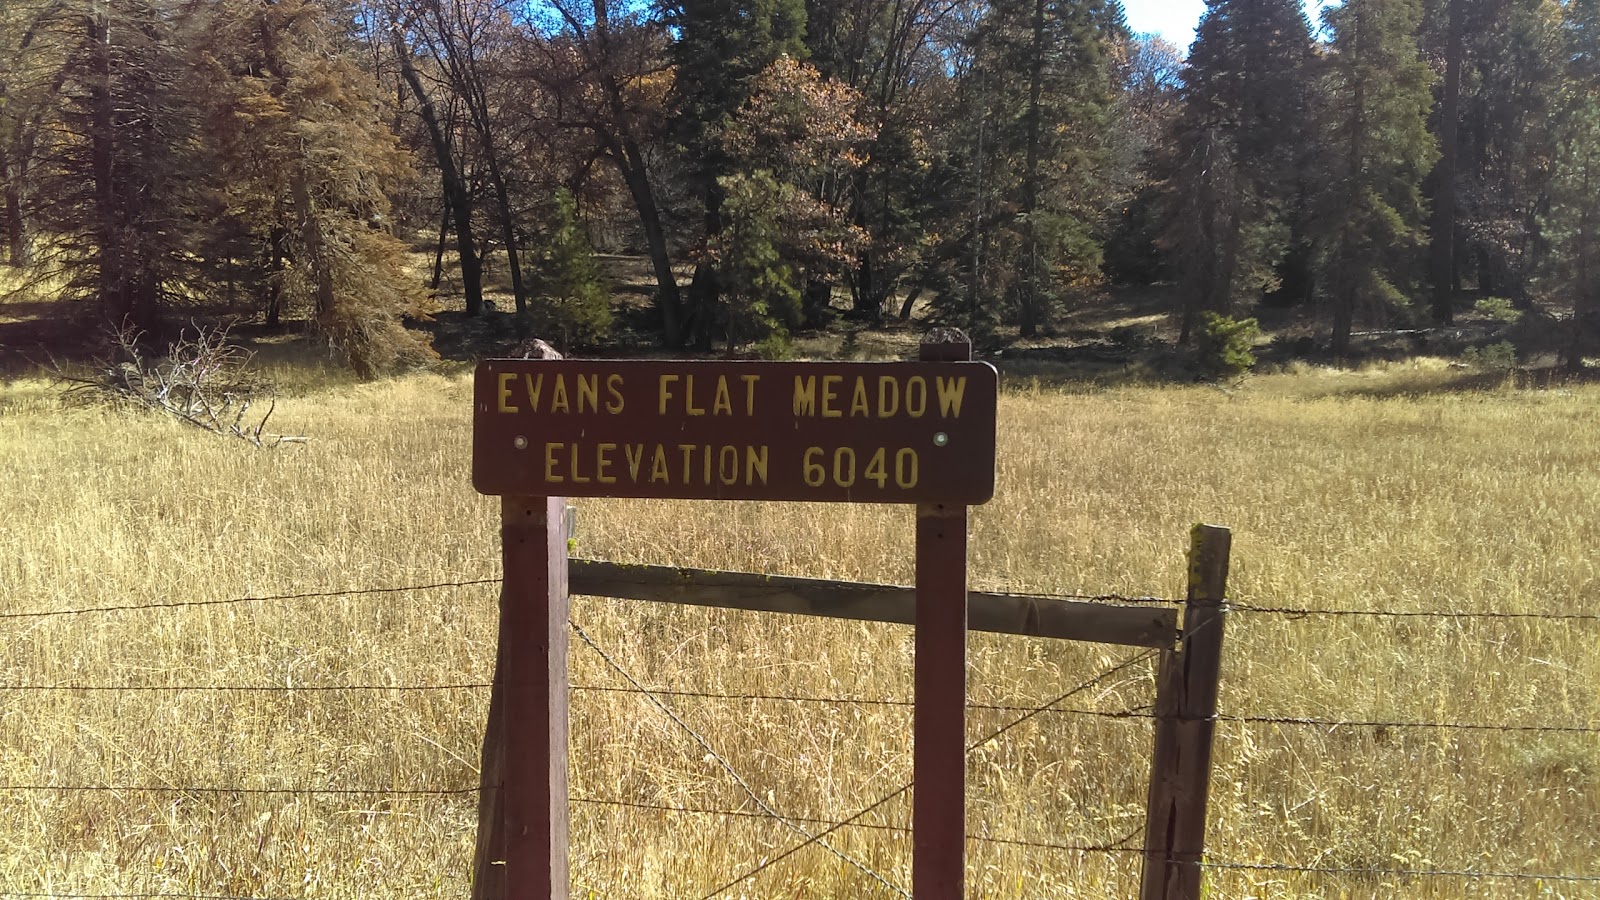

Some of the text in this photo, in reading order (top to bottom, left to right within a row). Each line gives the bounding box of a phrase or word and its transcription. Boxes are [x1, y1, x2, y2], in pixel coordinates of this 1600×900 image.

[497, 373, 967, 419] EVANS FLAT MEADOW
[544, 442, 919, 490] ELEVATION 6040
